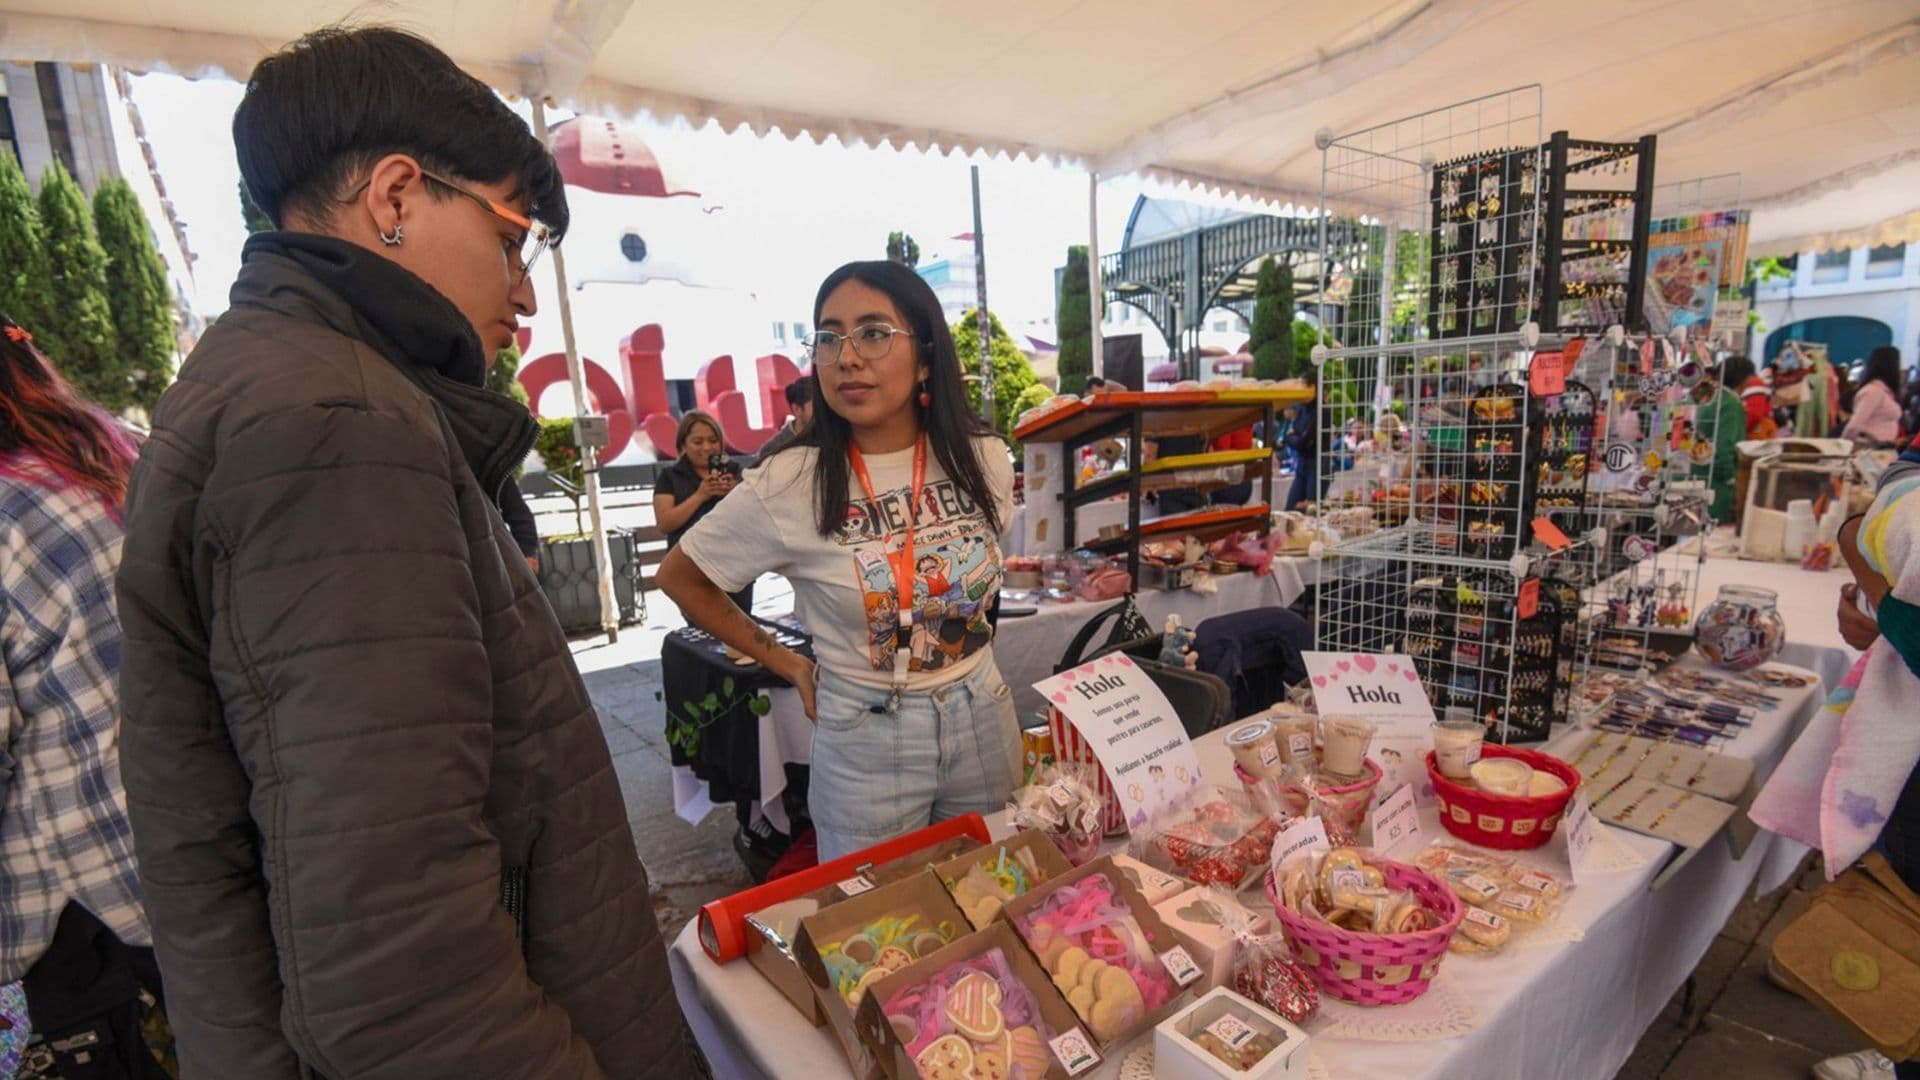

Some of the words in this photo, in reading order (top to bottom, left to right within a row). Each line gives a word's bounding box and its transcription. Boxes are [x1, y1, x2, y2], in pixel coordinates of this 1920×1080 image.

[515, 323, 812, 464] olu
[1075, 675, 1126, 700] Hola
[1346, 684, 1401, 704] Hola
[1107, 731, 1128, 746] postres
[1128, 725, 1140, 736] para
